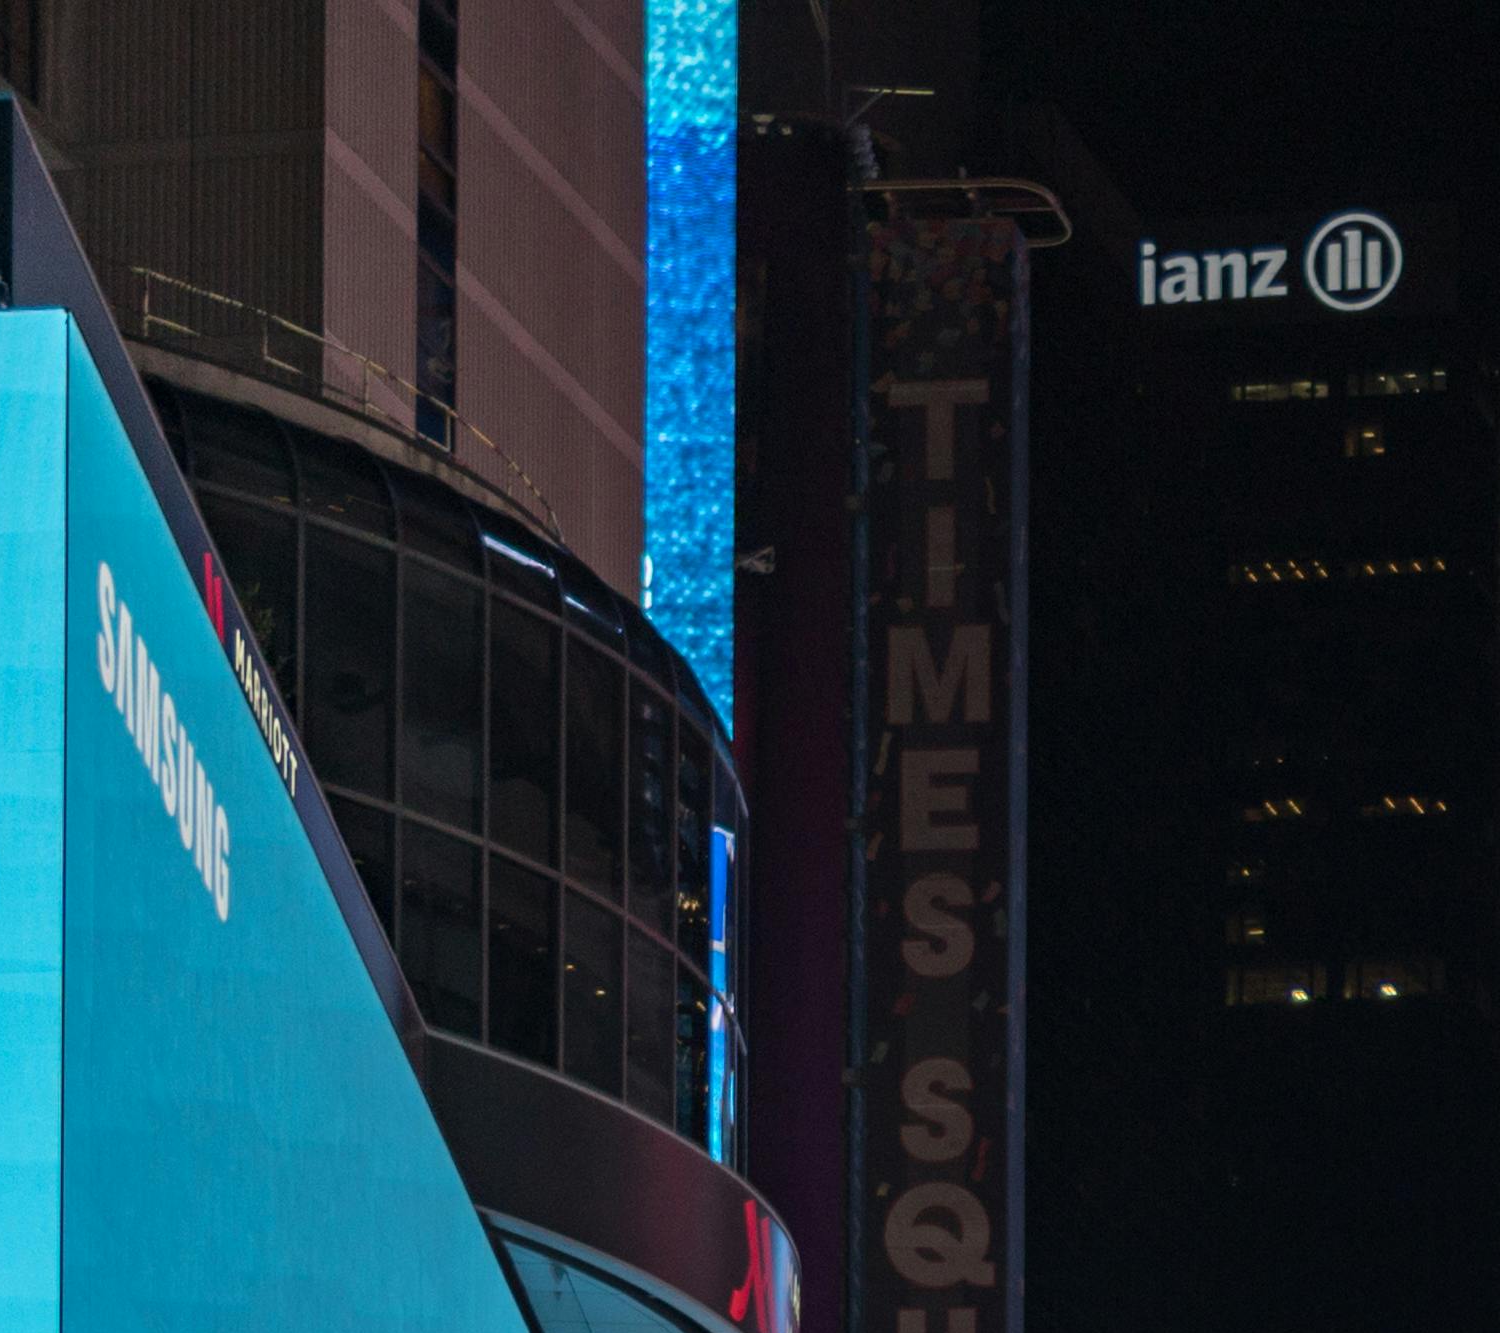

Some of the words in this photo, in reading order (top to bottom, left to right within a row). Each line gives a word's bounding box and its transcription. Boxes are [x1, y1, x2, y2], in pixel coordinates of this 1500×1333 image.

[97, 560, 230, 923] SAMSUNG
[235, 628, 298, 798] MARRIOTT
[884, 379, 993, 979] TIMES
